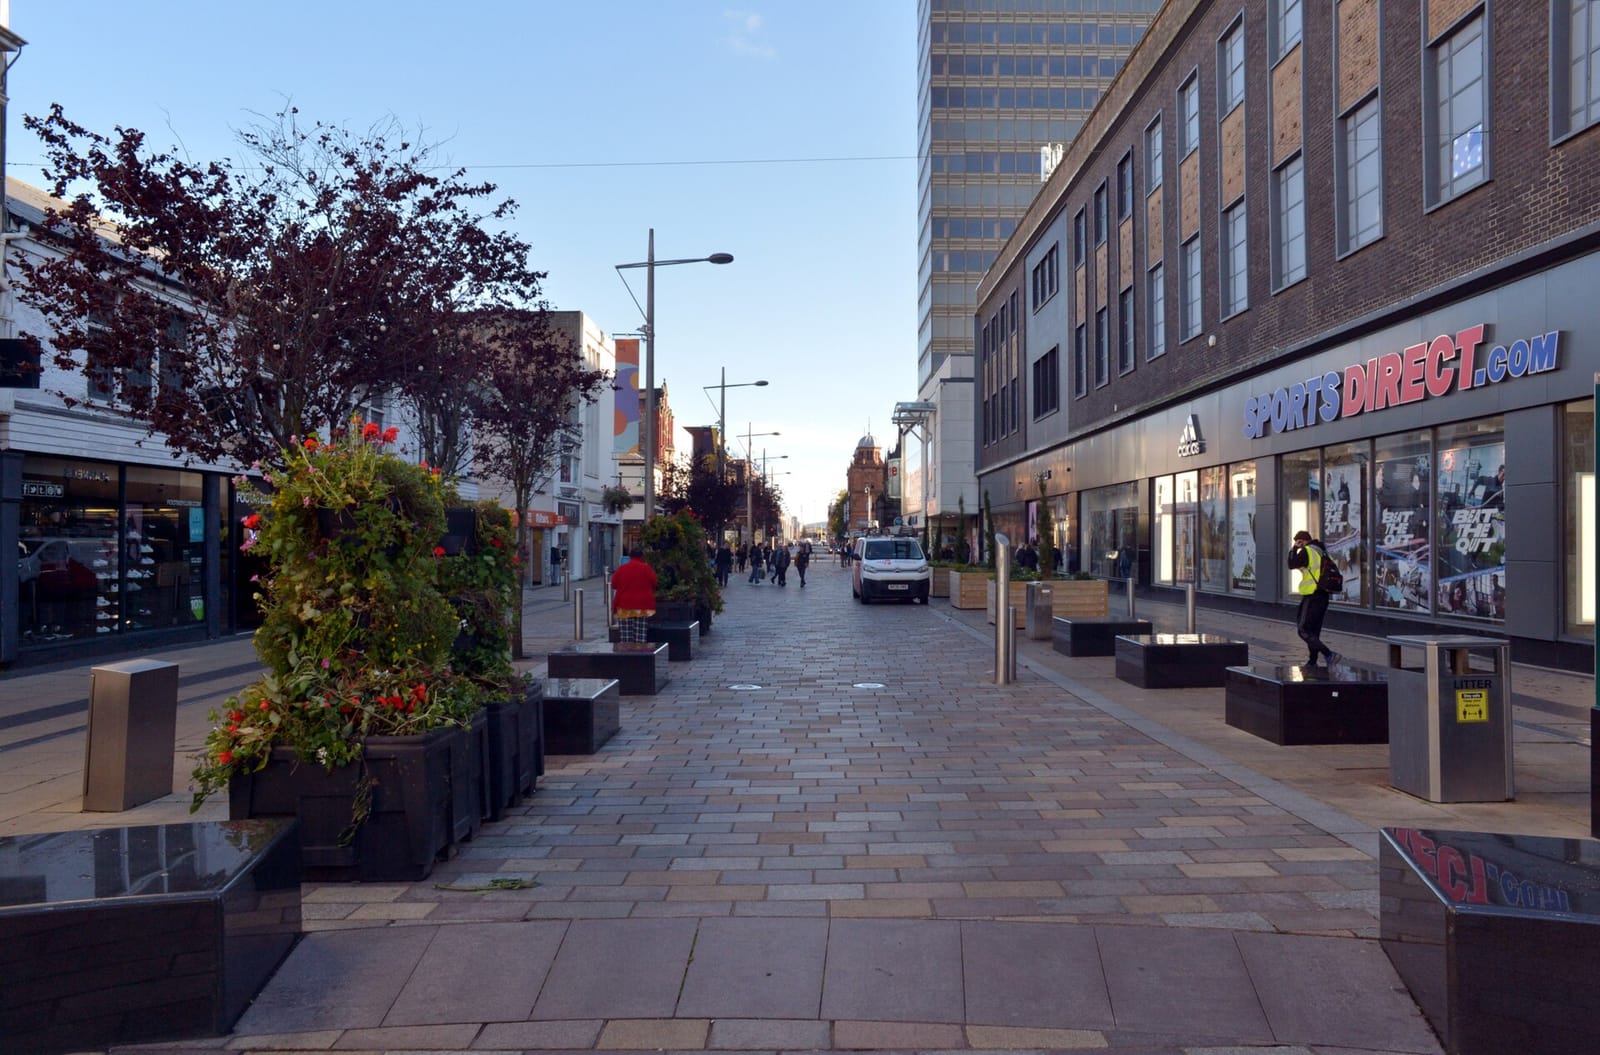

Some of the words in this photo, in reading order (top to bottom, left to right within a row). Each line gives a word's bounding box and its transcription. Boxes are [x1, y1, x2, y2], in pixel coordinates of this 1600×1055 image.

[1243, 323, 1560, 440] SPORTSDIRECT.COM
[1452, 508, 1499, 524] BEAT
[1385, 522, 1410, 535] THE
[1456, 523, 1491, 538] THE
[1455, 537, 1499, 555] QUIT
[1453, 679, 1493, 689] LITTER
